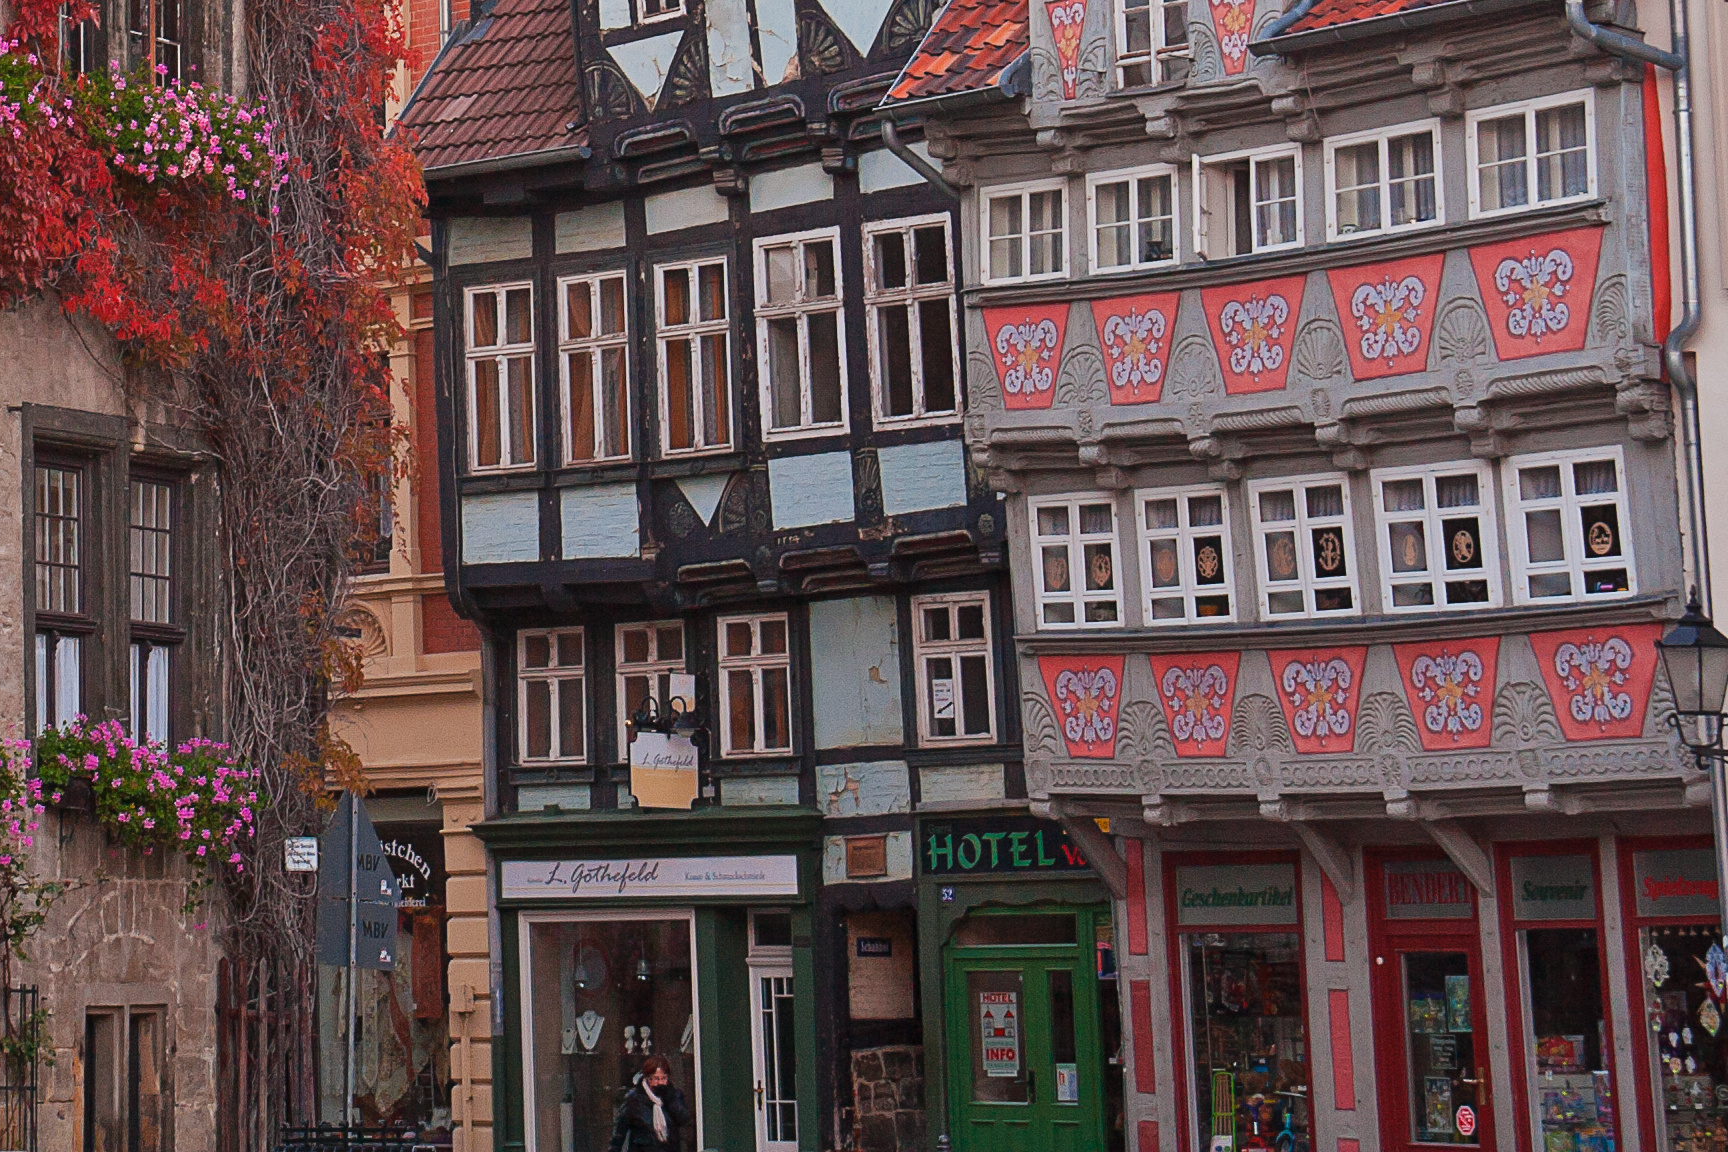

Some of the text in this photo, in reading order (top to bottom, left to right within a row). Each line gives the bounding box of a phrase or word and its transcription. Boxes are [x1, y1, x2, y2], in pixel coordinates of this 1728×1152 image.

[653, 753, 694, 773] Gothefeld
[927, 829, 1056, 870] HOTEL
[396, 873, 415, 888] rkt
[545, 861, 567, 884] L.
[571, 861, 659, 894] Gothefeld
[1181, 885, 1294, 908] Geschenkartikel
[1522, 879, 1588, 901] Souvenir
[362, 920, 389, 938] MBV
[982, 993, 1014, 1003] HOTEL
[986, 1048, 1016, 1061] INFO
